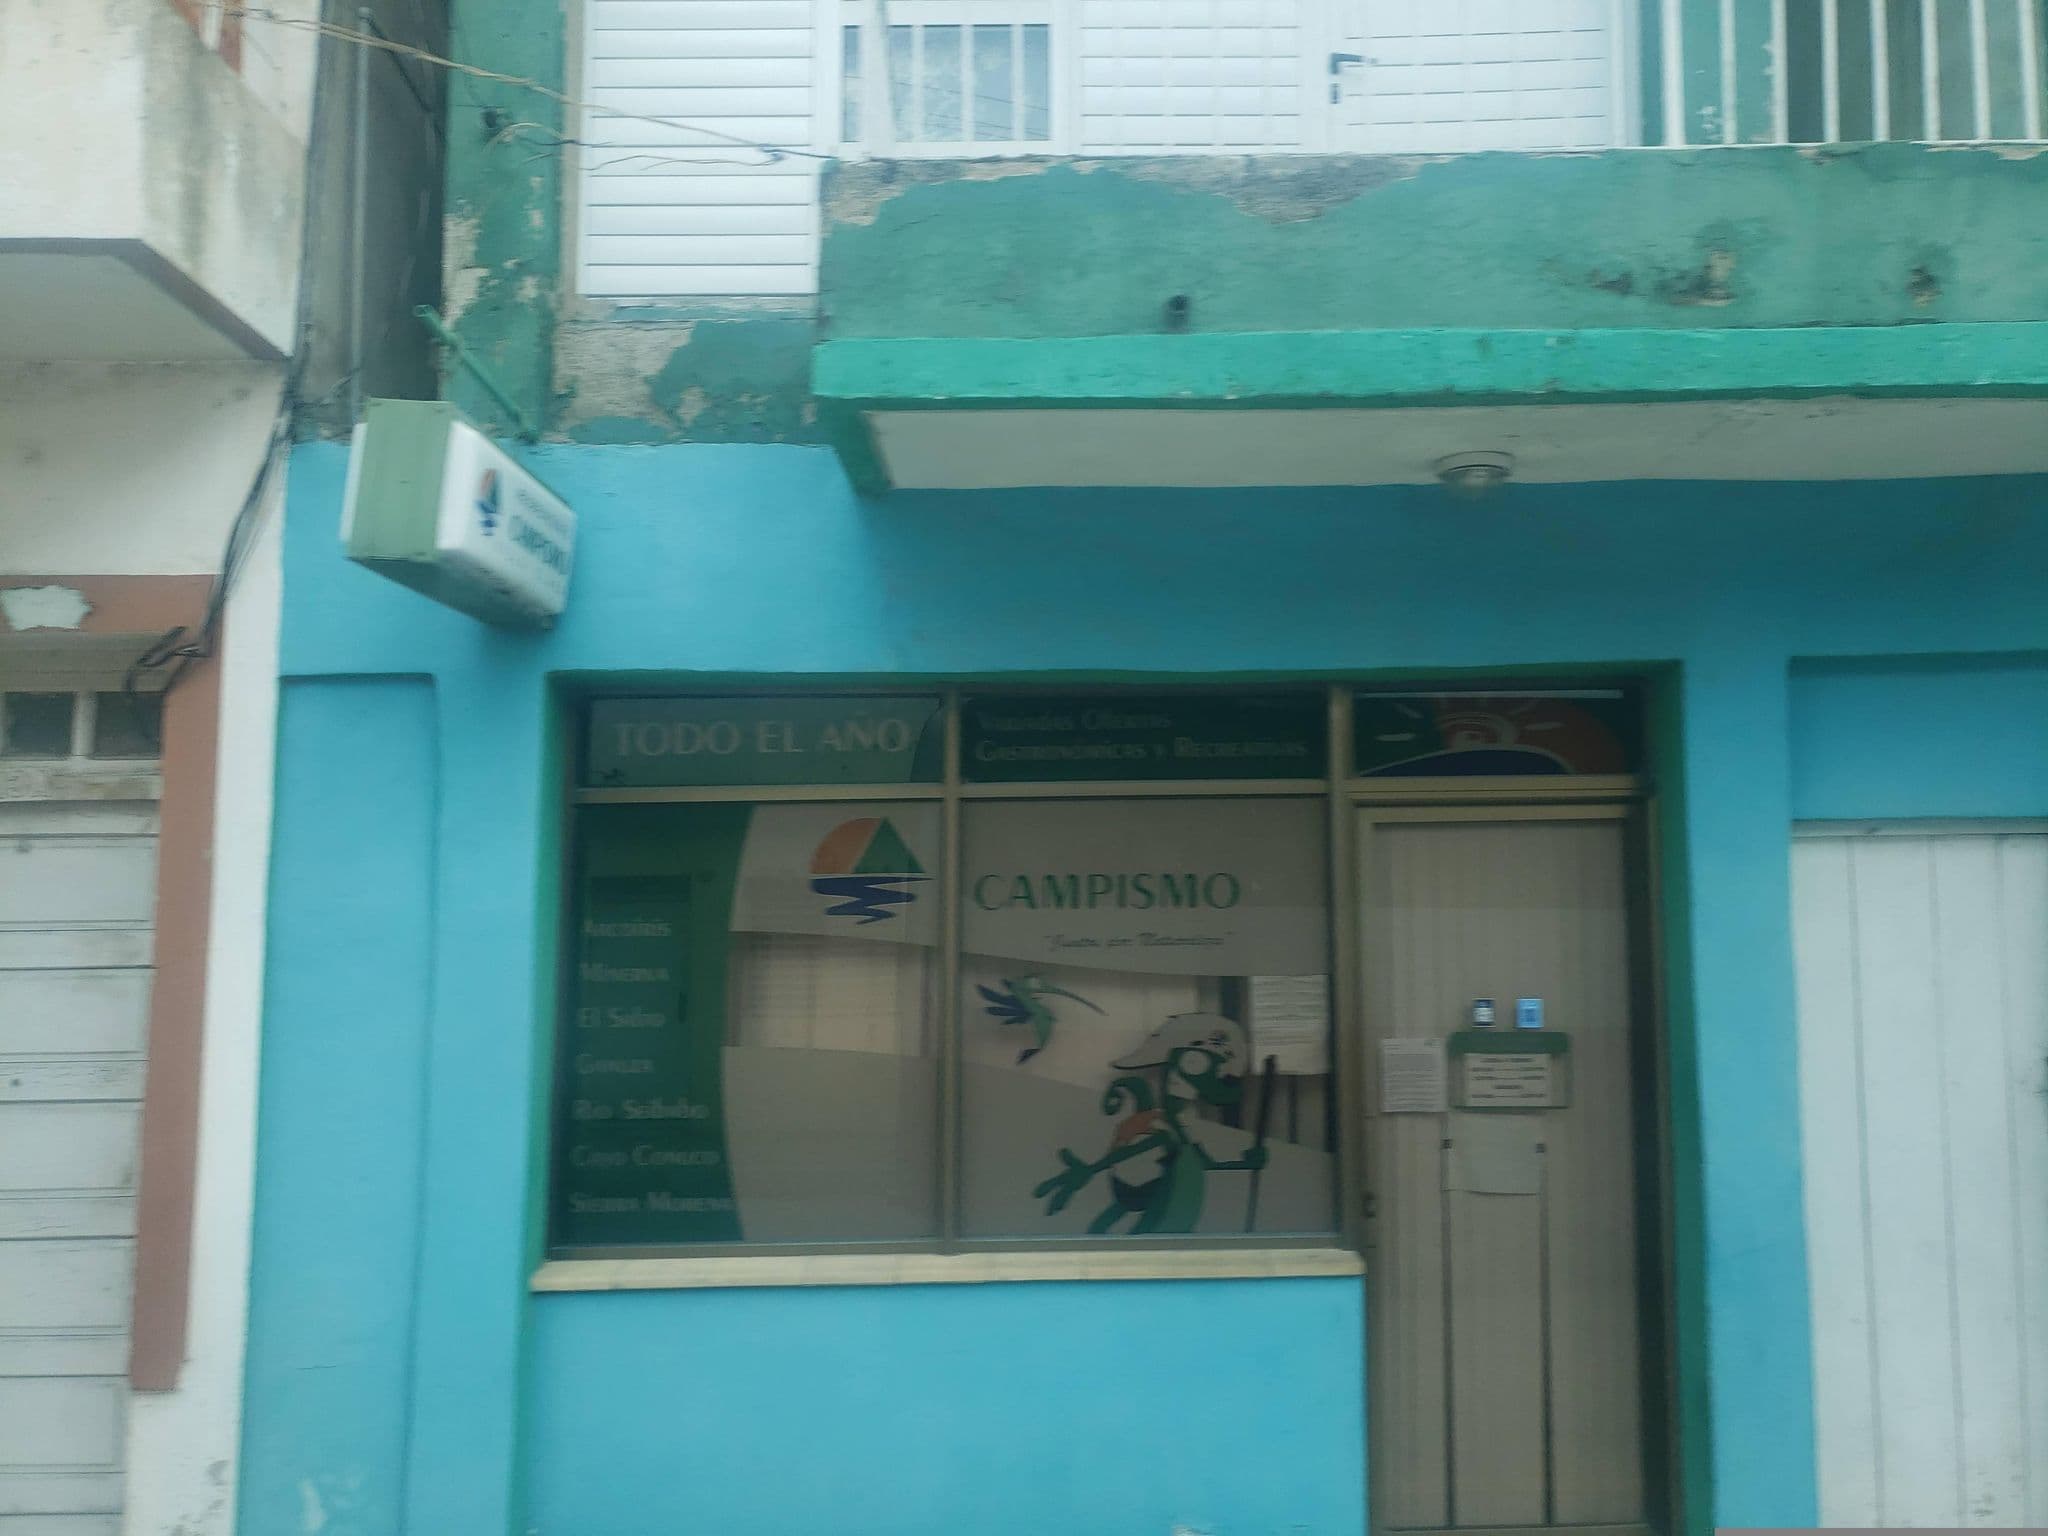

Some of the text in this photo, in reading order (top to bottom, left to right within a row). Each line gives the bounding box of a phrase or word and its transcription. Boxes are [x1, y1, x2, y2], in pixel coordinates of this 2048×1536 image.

[612, 712, 913, 756] TODO EL AÑO
[974, 872, 1241, 911] CAMPISMO
